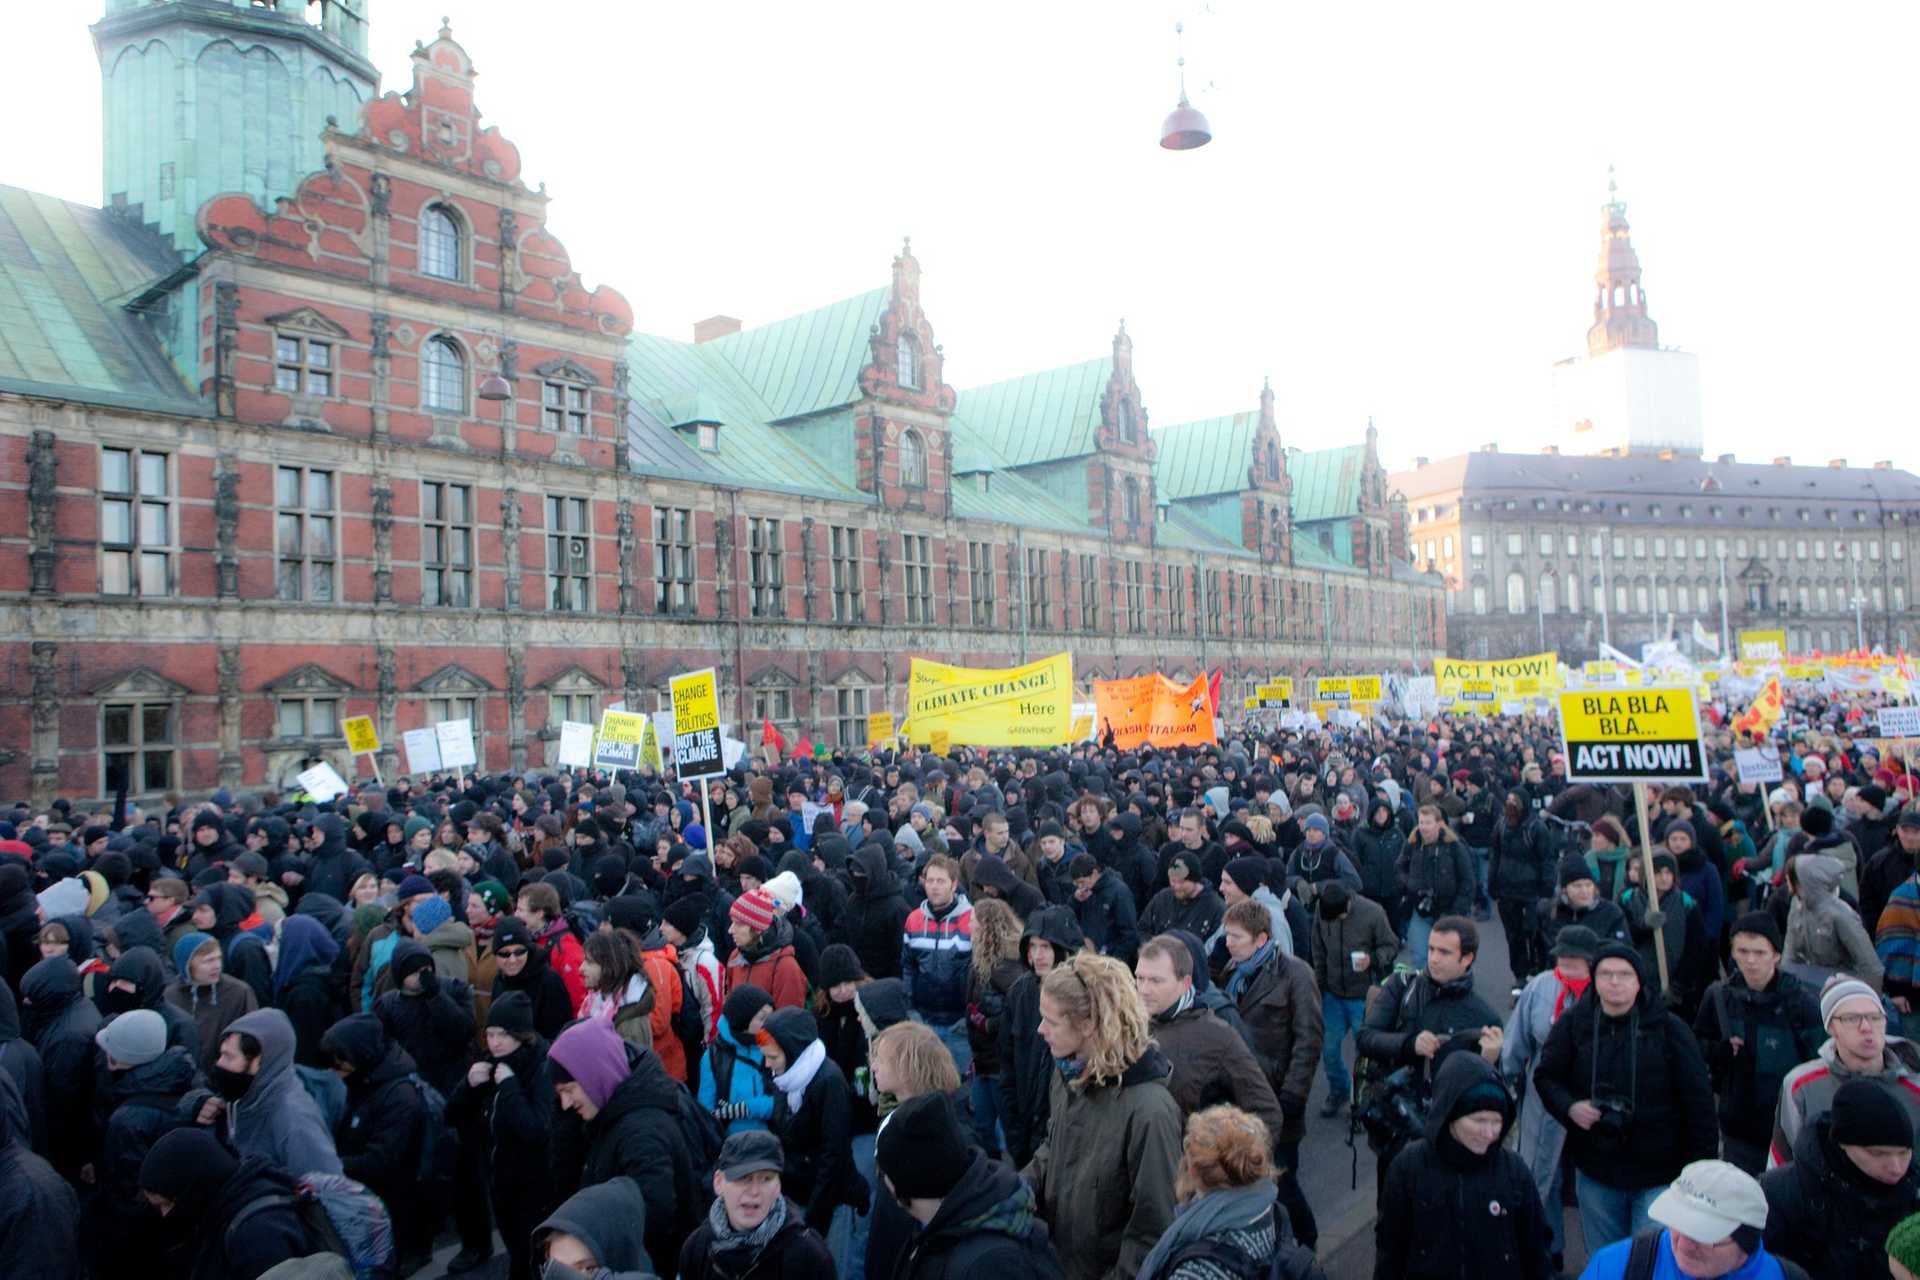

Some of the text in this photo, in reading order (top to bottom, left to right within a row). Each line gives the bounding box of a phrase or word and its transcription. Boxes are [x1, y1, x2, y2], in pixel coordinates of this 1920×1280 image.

[1443, 661, 1549, 679] ACT NOW!
[673, 684, 708, 703] CHANGE
[916, 671, 1049, 713] CLIMATE CHANGE
[675, 703, 691, 717] THE
[1020, 702, 1055, 715] Here
[1582, 695, 1669, 715] BLA BLA
[675, 712, 715, 732] POLITICS
[1600, 717, 1657, 735] BLA...
[677, 729, 715, 750] NOT THE
[678, 743, 718, 765] CLIMATE
[1576, 743, 1692, 770] ACT NOW!
